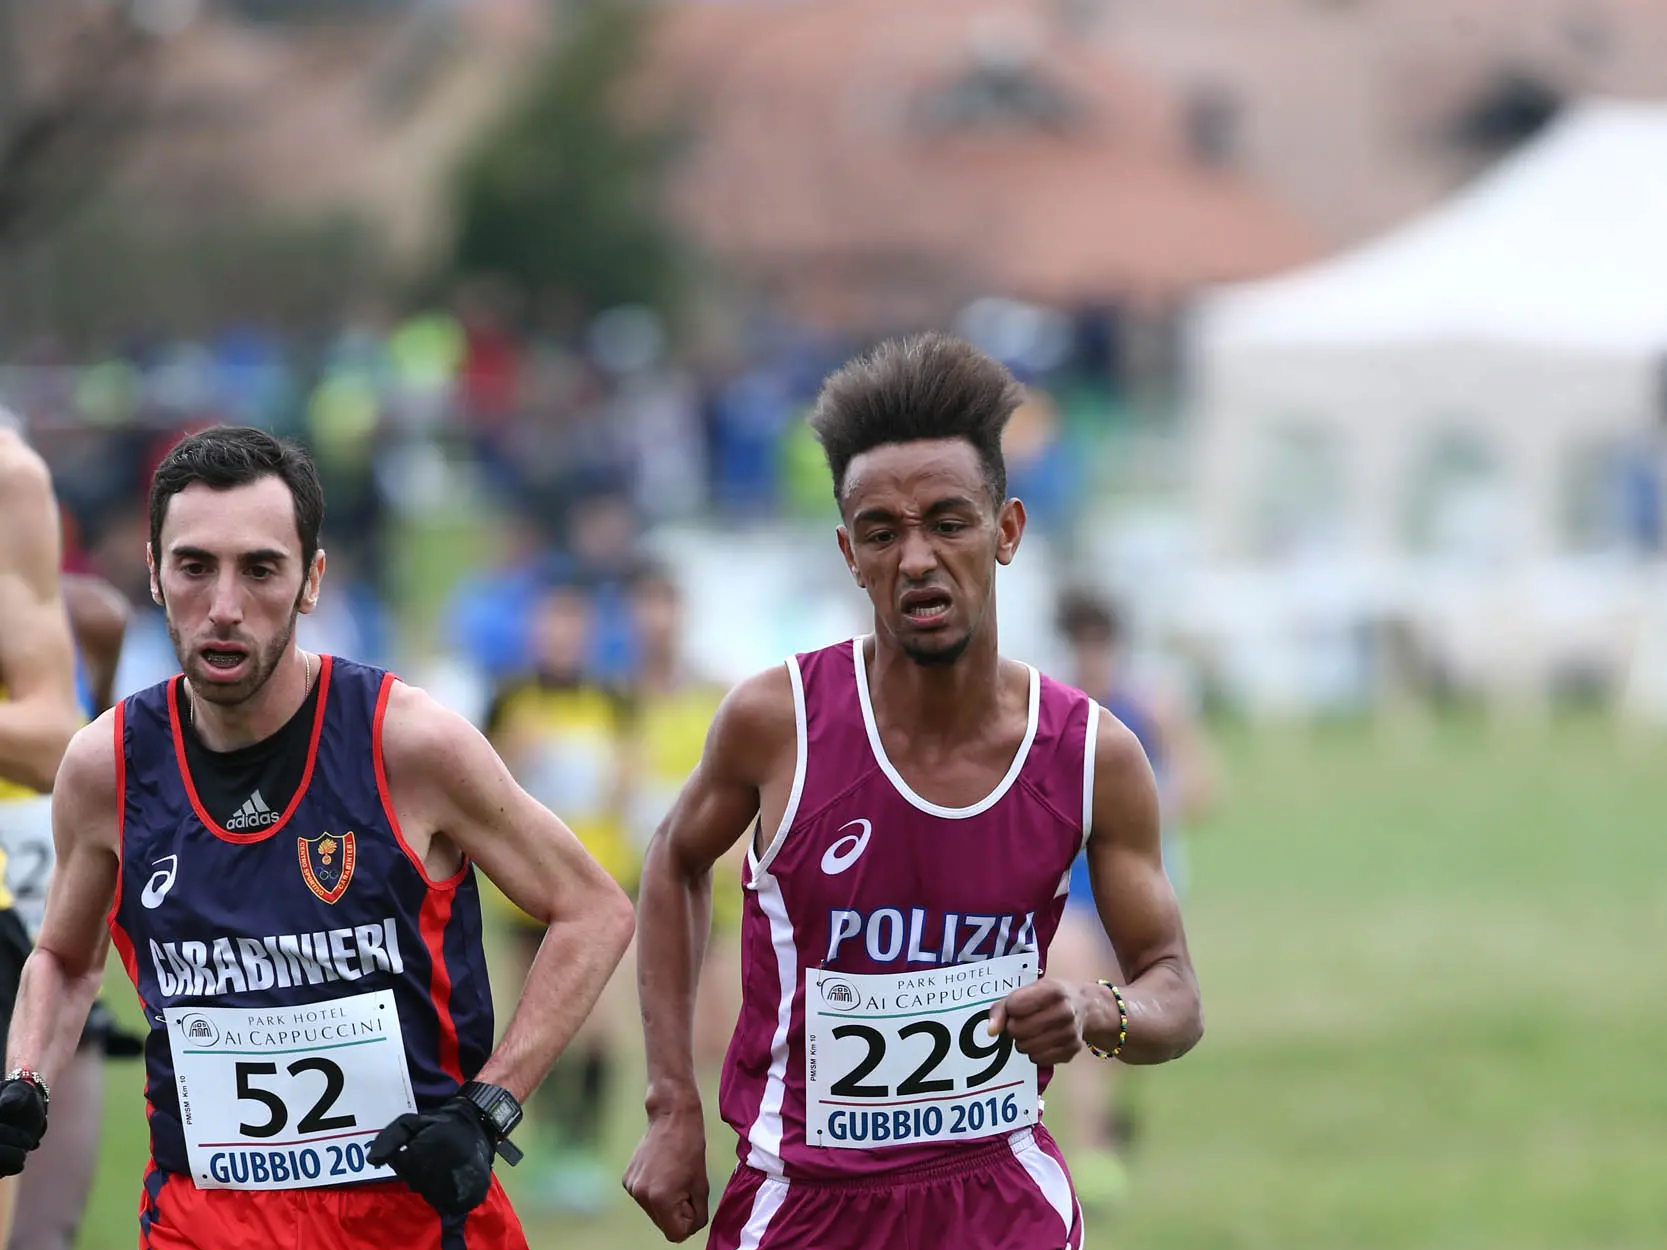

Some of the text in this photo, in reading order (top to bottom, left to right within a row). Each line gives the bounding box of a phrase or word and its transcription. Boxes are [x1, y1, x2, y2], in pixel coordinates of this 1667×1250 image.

[226, 812, 280, 830] adidas
[300, 842, 324, 895] CENTRO SPORTIVO
[338, 841, 353, 890] CARABINIERI
[149, 917, 405, 997] CARABINIERI
[825, 907, 1037, 964] POLIZIA
[895, 975, 1022, 1009] CAPPUCCINI
[897, 967, 993, 990] PARK HOTEL
[248, 1007, 347, 1027] PARK HOTEL
[249, 1018, 383, 1046] CAPPUCCINI
[830, 1008, 1015, 1097] 229
[235, 1057, 357, 1138] 52
[827, 1093, 1018, 1142] GUBBIO 2016
[210, 1140, 382, 1183] GUBBIO 20
